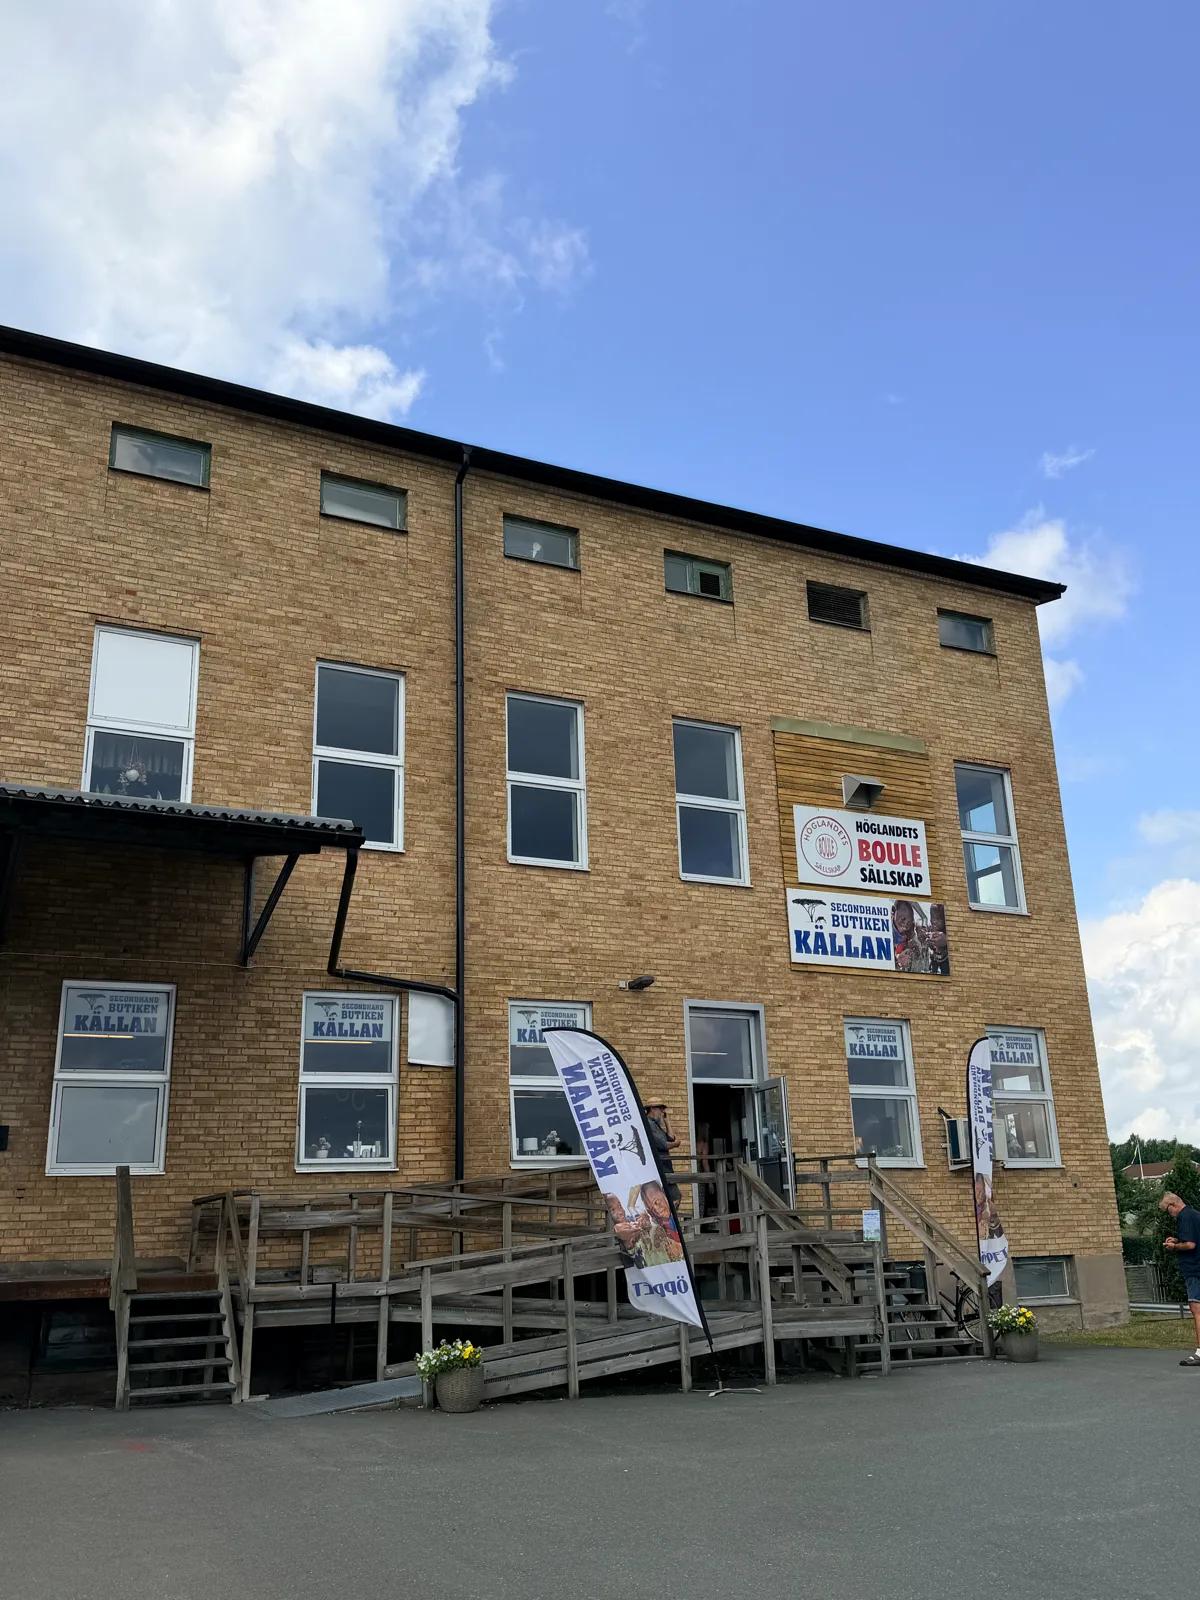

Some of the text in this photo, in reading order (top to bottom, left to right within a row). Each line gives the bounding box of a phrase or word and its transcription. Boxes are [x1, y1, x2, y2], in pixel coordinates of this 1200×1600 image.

[856, 819, 918, 839] HÖGLANDETS
[857, 839, 922, 867] BOULE
[860, 864, 923, 888] SÄLLSKAP
[830, 902, 888, 916] SECONDHAND
[831, 914, 890, 932] BUTIKEN
[794, 925, 892, 960] KÄLLAN
[108, 1003, 158, 1014] BUTIKEN
[341, 1010, 384, 1020] BUTIKEN
[74, 1011, 158, 1033] KÄLLAN
[313, 1018, 383, 1038] KÄLLAN
[541, 1018, 577, 1028] BUTIKEN
[867, 1034, 896, 1042] BUTIKEN
[1006, 1042, 1032, 1050] BUTIKEN
[849, 1040, 898, 1057] KÄLLAN
